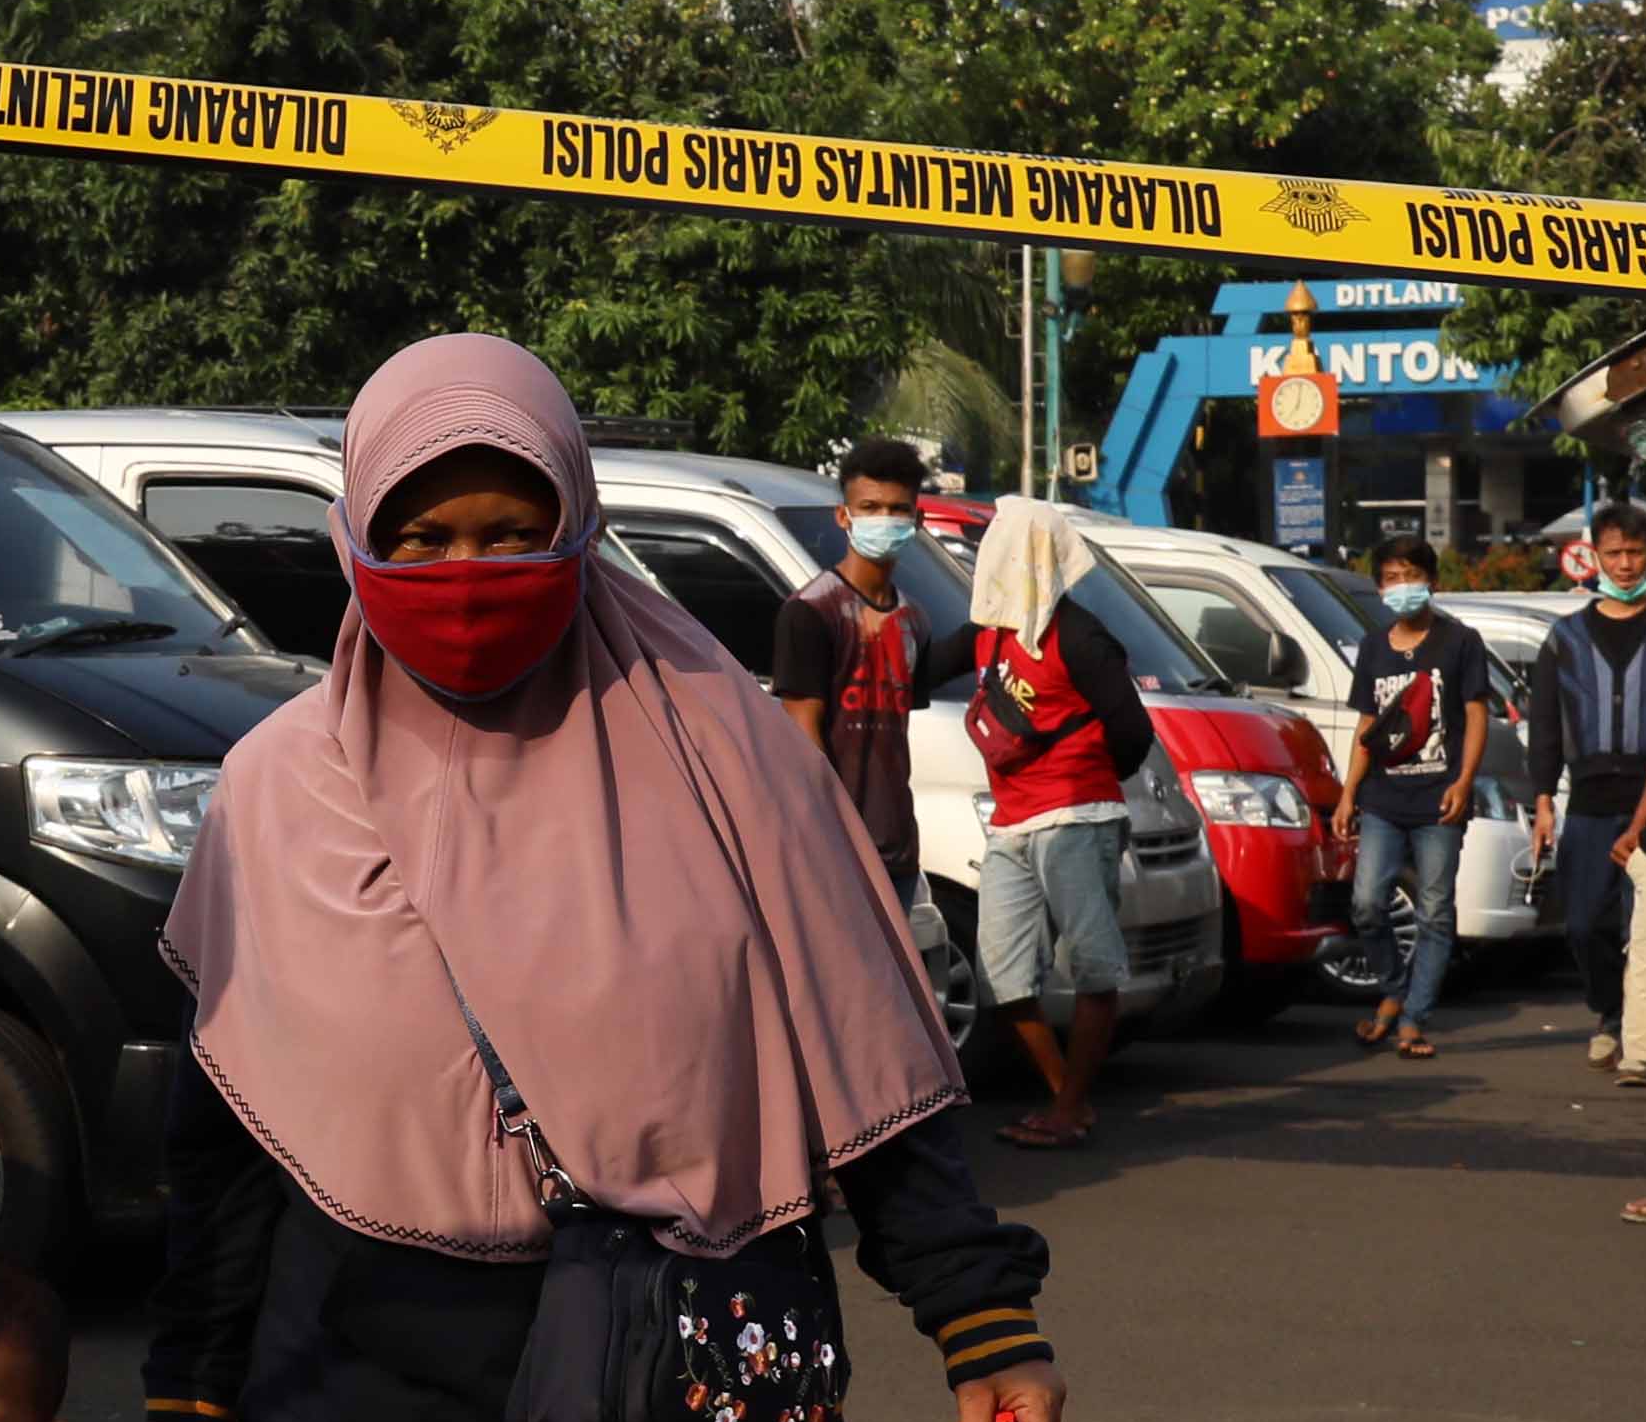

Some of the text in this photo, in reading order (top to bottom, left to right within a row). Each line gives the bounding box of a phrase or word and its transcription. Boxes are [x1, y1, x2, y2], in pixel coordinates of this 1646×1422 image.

[147, 81, 347, 156] DILARANG
[542, 118, 1223, 238] DILARANG MELINTAS GARIS POLISI
[1405, 201, 1535, 266] POLISI
[1336, 281, 1465, 308] DITLANT
[1250, 340, 1479, 386] KNTOR
